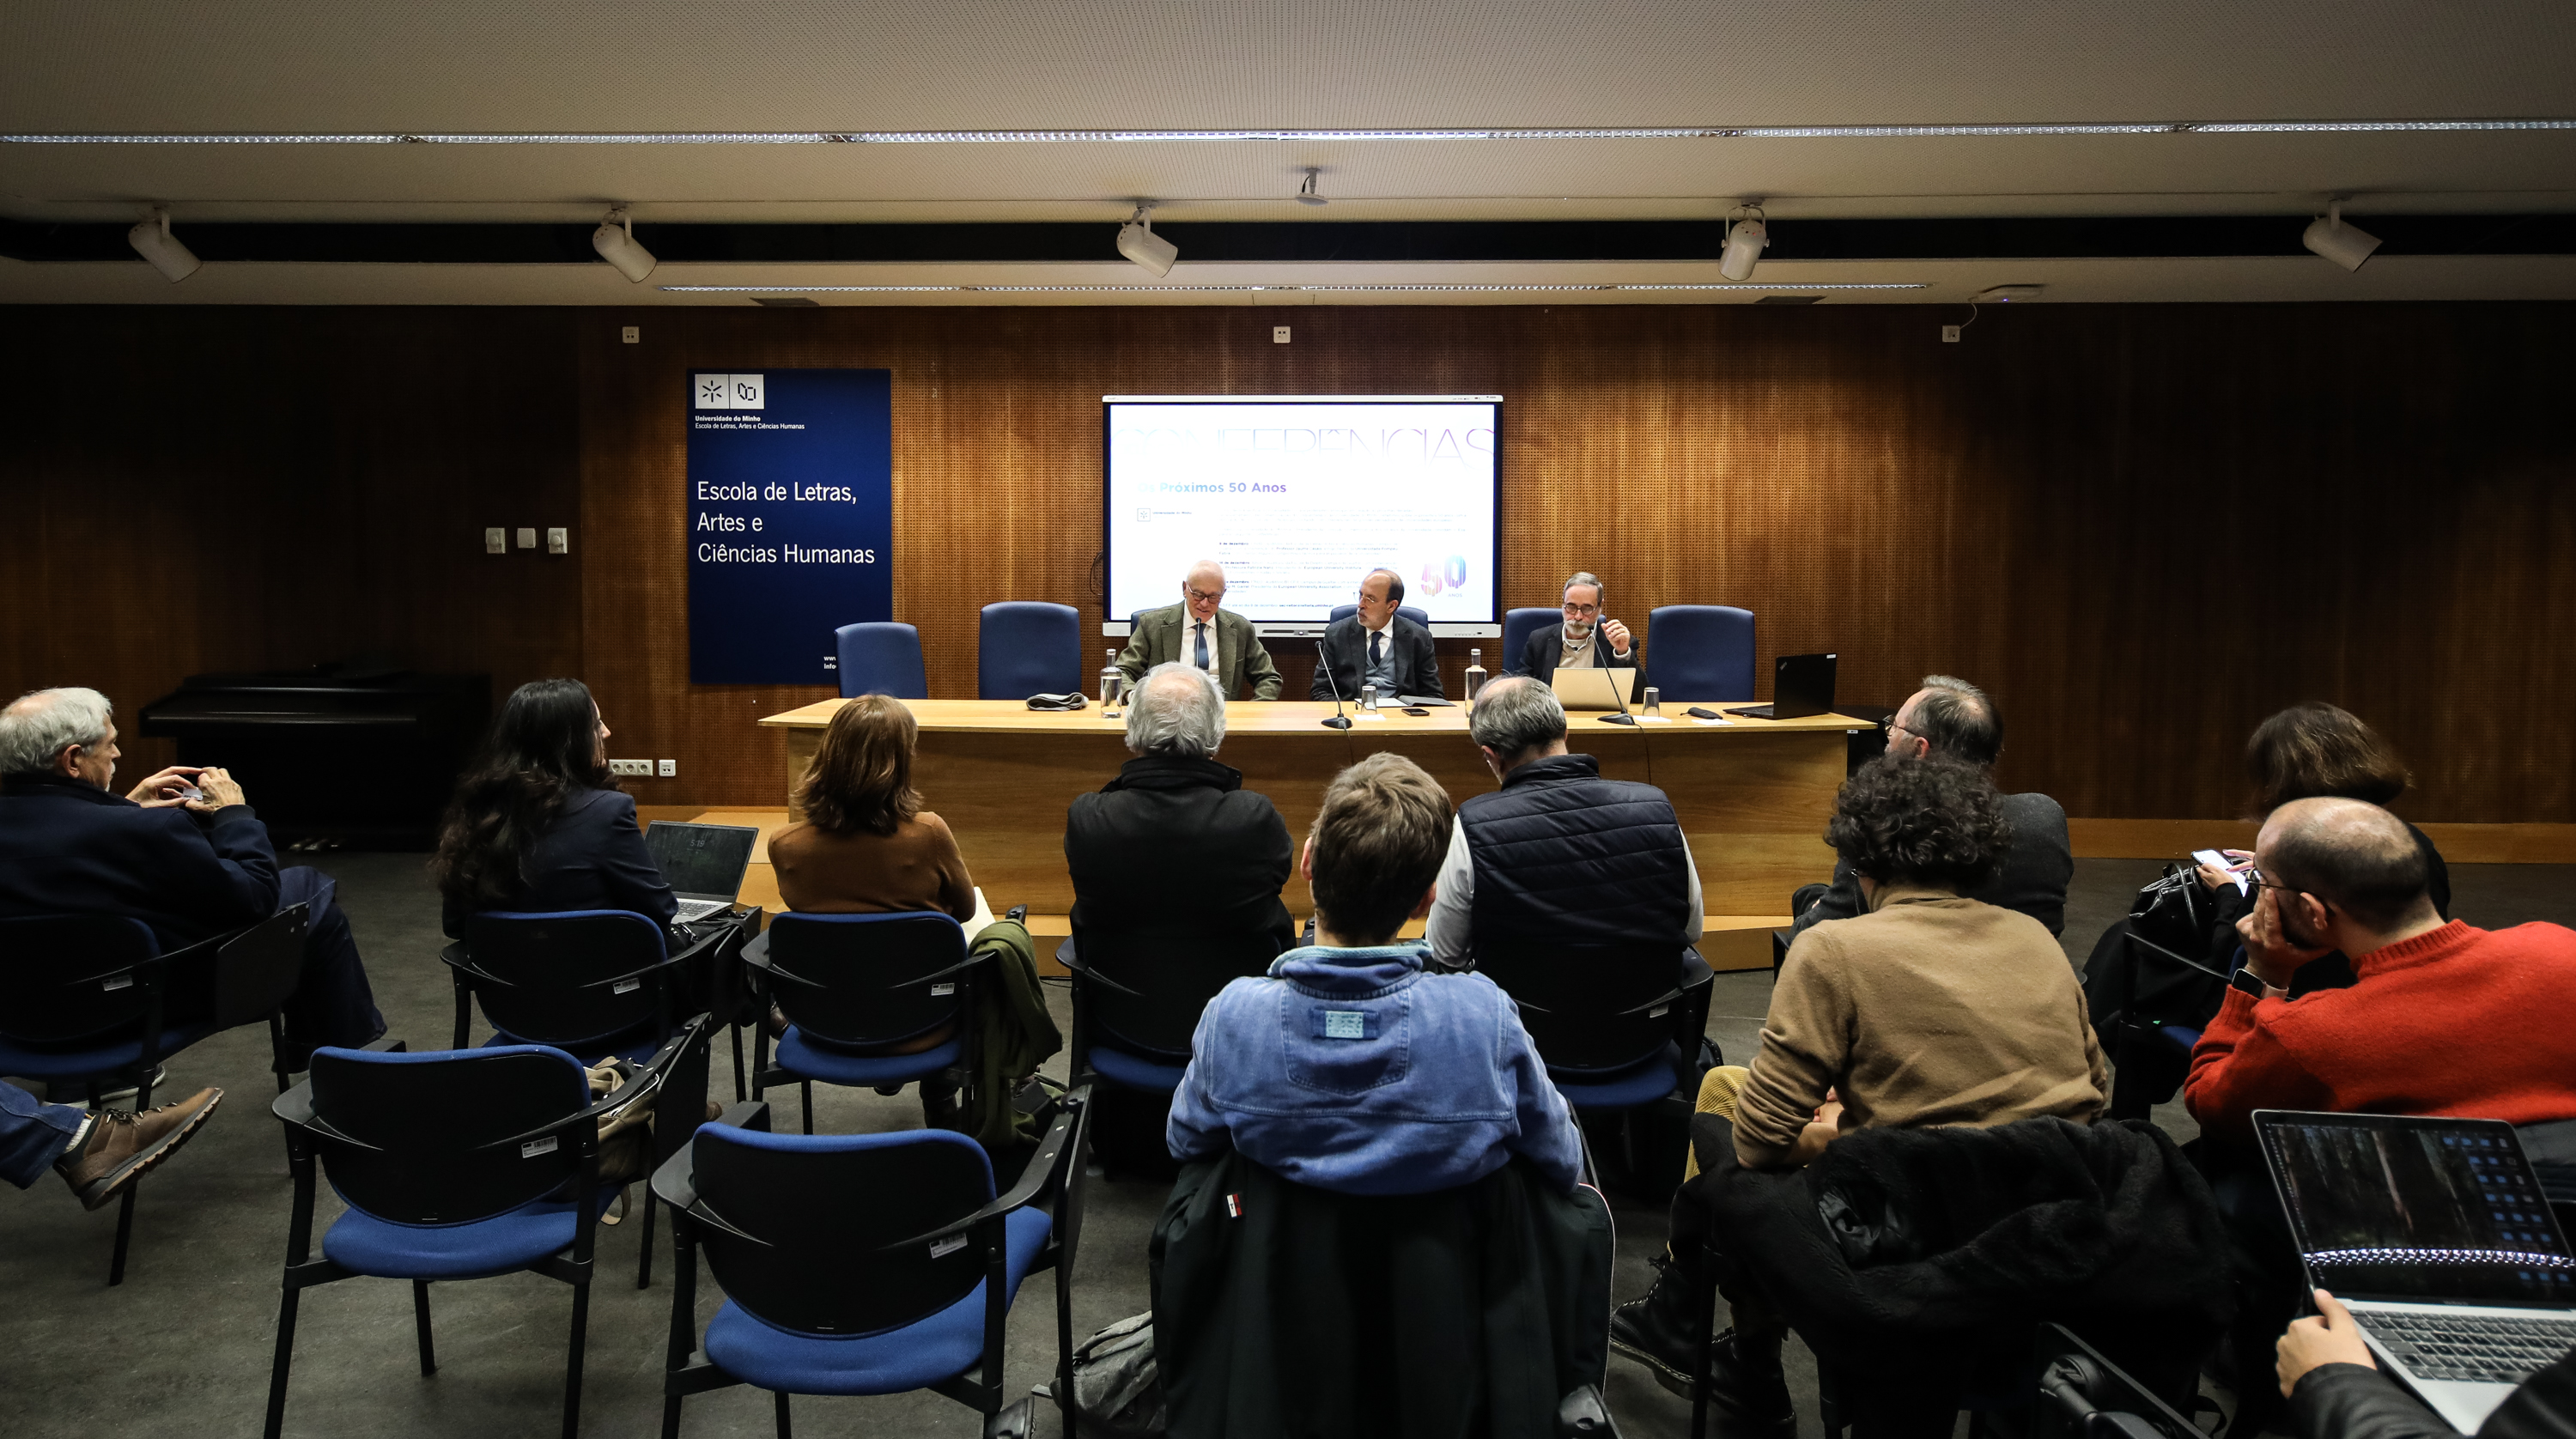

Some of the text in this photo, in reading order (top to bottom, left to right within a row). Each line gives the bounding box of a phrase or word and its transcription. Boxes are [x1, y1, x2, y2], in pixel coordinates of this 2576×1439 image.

[697, 481, 857, 505] Escola de Letras,
[1159, 481, 1224, 493] Próximos
[1229, 482, 1247, 493] 50
[1251, 482, 1287, 493] Anos
[696, 512, 763, 532] Artes e
[698, 543, 875, 564] Ciências Humanas
